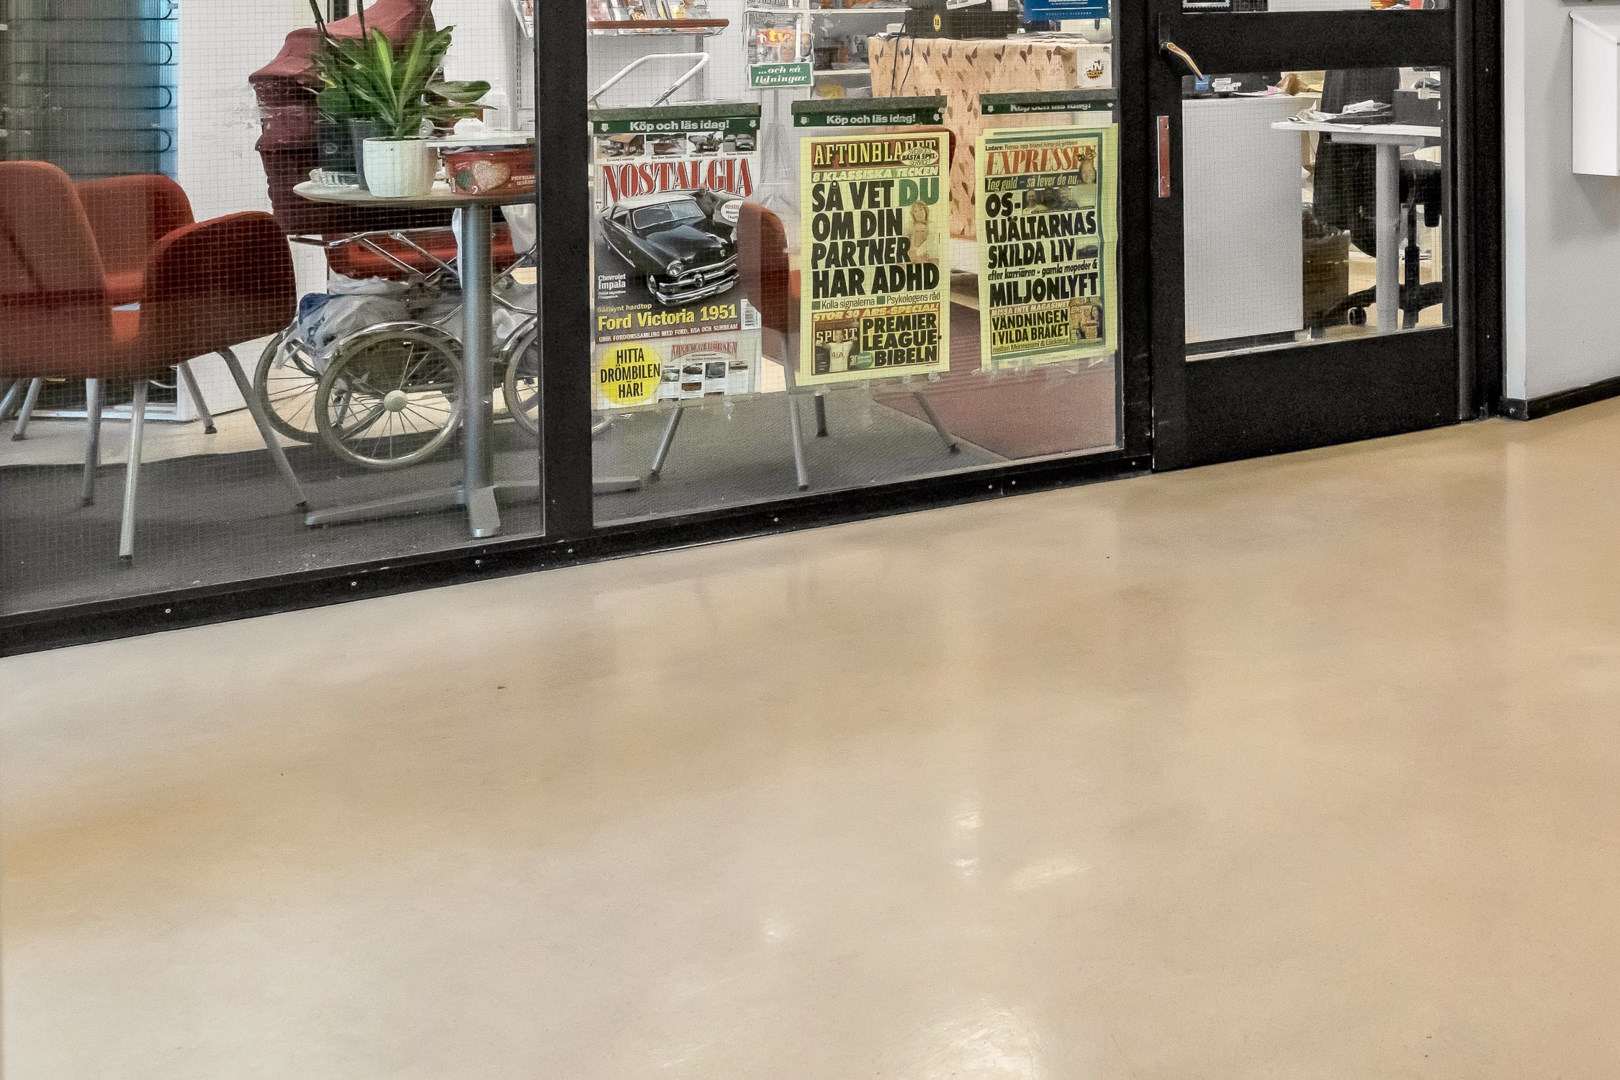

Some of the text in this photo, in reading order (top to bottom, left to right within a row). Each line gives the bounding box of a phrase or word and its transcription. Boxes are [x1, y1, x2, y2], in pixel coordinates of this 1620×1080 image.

[630, 120, 730, 132] Köp och läs idag!
[826, 113, 916, 125] Köp och läs idag!
[601, 158, 754, 208] NOSTALGIA
[822, 168, 893, 182] KLASSISKA
[896, 165, 939, 178] TECKEN
[812, 177, 940, 212] SÅ VET DU
[985, 192, 1021, 218] OS-
[812, 208, 903, 242] OM DIN
[985, 210, 1097, 244] HJÄLTARNAS
[811, 236, 911, 270] PARTNER
[987, 238, 1076, 270] SKILDA LIV
[598, 273, 626, 281] Chevrolet
[812, 262, 940, 300] HAR ADHD
[987, 269, 1004, 281] efter
[1004, 267, 1036, 280] karriären
[1041, 263, 1063, 278] gamla
[1064, 261, 1091, 273] mopeder
[1092, 259, 1098, 270] &
[598, 279, 626, 291] Impala
[989, 272, 1099, 309] MILJONLYFT
[625, 303, 653, 312] hardtop
[820, 297, 876, 310] Kolla signalerna
[886, 291, 941, 305] Psykologens råd
[598, 303, 738, 332] Ford Victoria 1951
[862, 312, 938, 335] PREMIER
[991, 308, 1069, 331] VÄNDNINGEN
[816, 327, 859, 343] SPT
[862, 331, 943, 352] LEAGUE-
[998, 328, 1029, 345] VILDA
[1030, 322, 1070, 341] BRÅKET
[616, 347, 645, 364] HITTA
[874, 345, 938, 367] BIBELN
[600, 362, 661, 384] DRÖMBILEN
[618, 380, 644, 399] HÄR!
